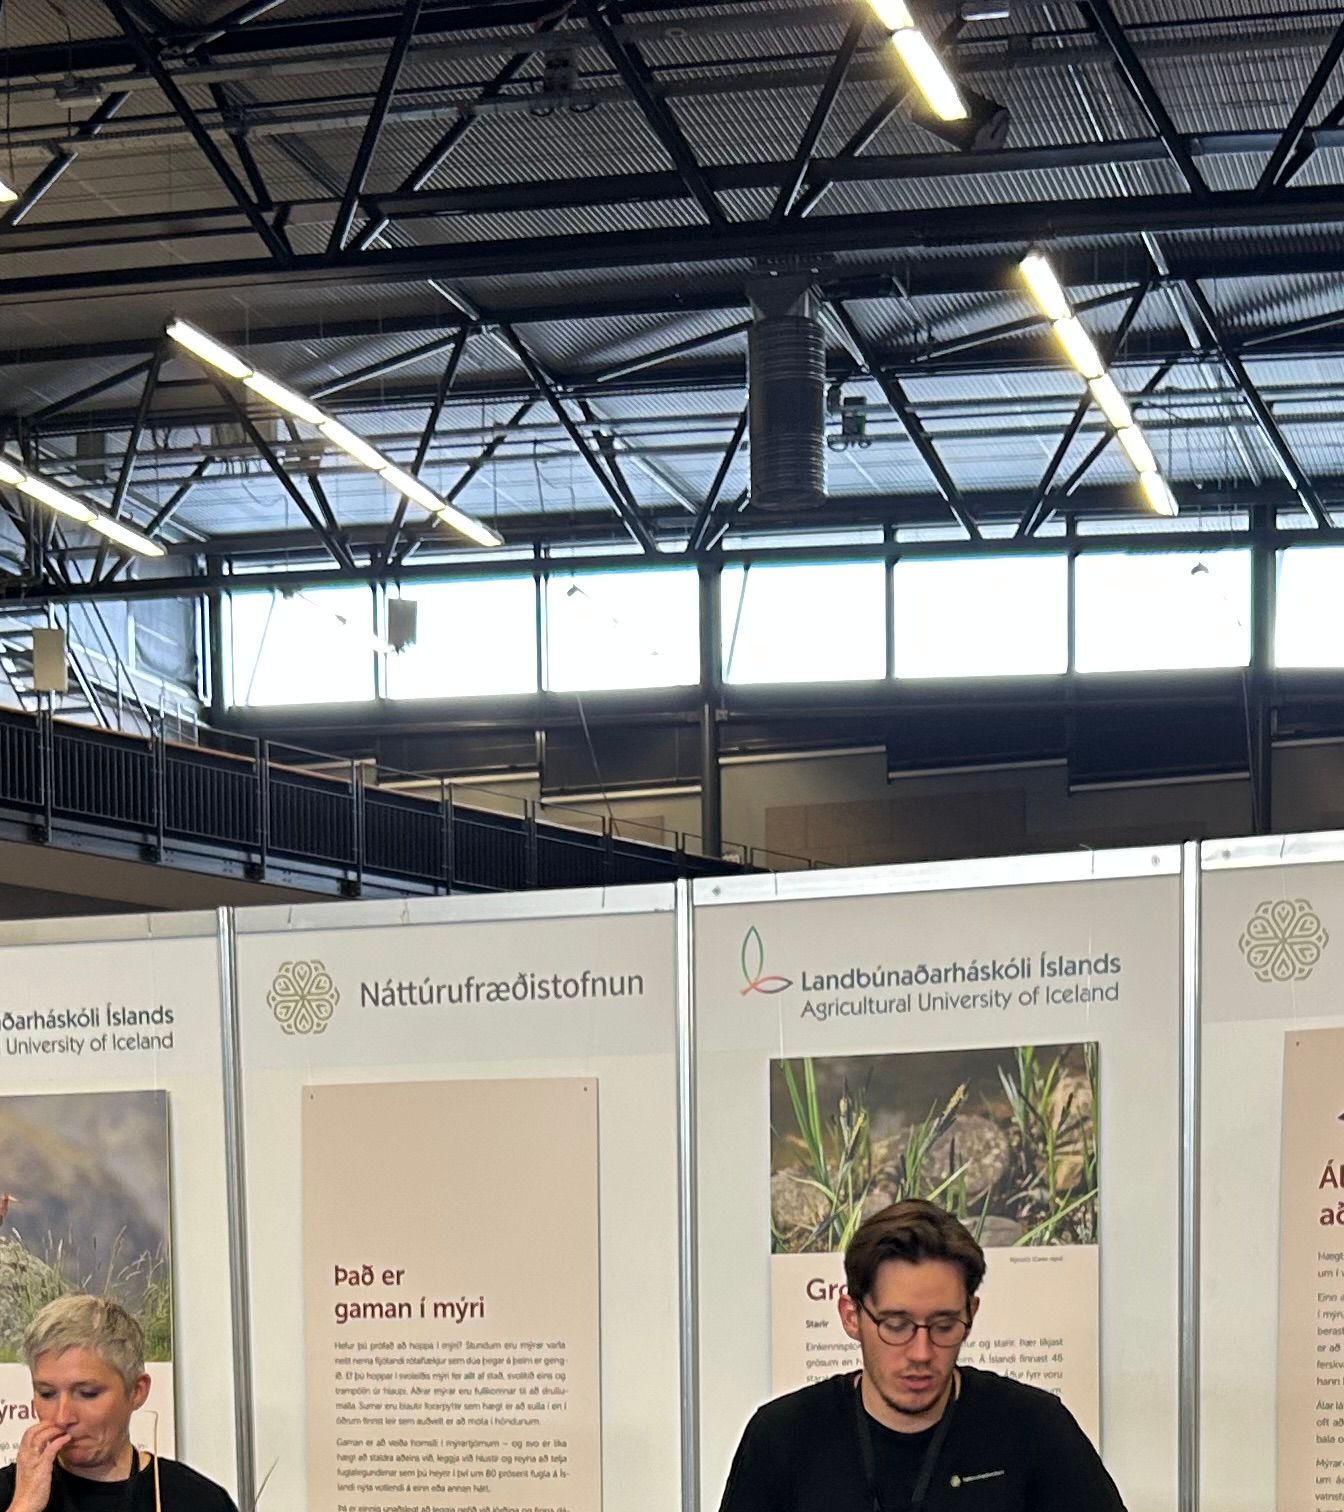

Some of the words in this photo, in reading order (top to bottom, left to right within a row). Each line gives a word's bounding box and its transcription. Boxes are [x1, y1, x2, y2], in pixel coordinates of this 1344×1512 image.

[802, 957, 1031, 991] Landbúnaðarháskóli
[1041, 952, 1121, 983] Íslands
[361, 970, 643, 1007] Náttúrufræðistofnun
[801, 995, 911, 1021] Agricultural
[919, 984, 1012, 1011] University
[1019, 986, 1039, 1006] of
[1046, 982, 1118, 1004] Iceland
[107, 1003, 174, 1026] Íslands
[7, 1034, 84, 1055] University
[90, 1034, 107, 1051] of
[113, 1032, 173, 1050] Iceland
[334, 1264, 374, 1286] Það
[382, 1269, 405, 1286] er
[335, 1302, 412, 1324] gaman
[420, 1297, 425, 1318] í
[433, 1297, 484, 1324] mýri
[978, 1340, 990, 1350] og
[1329, 1343, 1341, 1352] að
[1333, 1418, 1344, 1427] að
